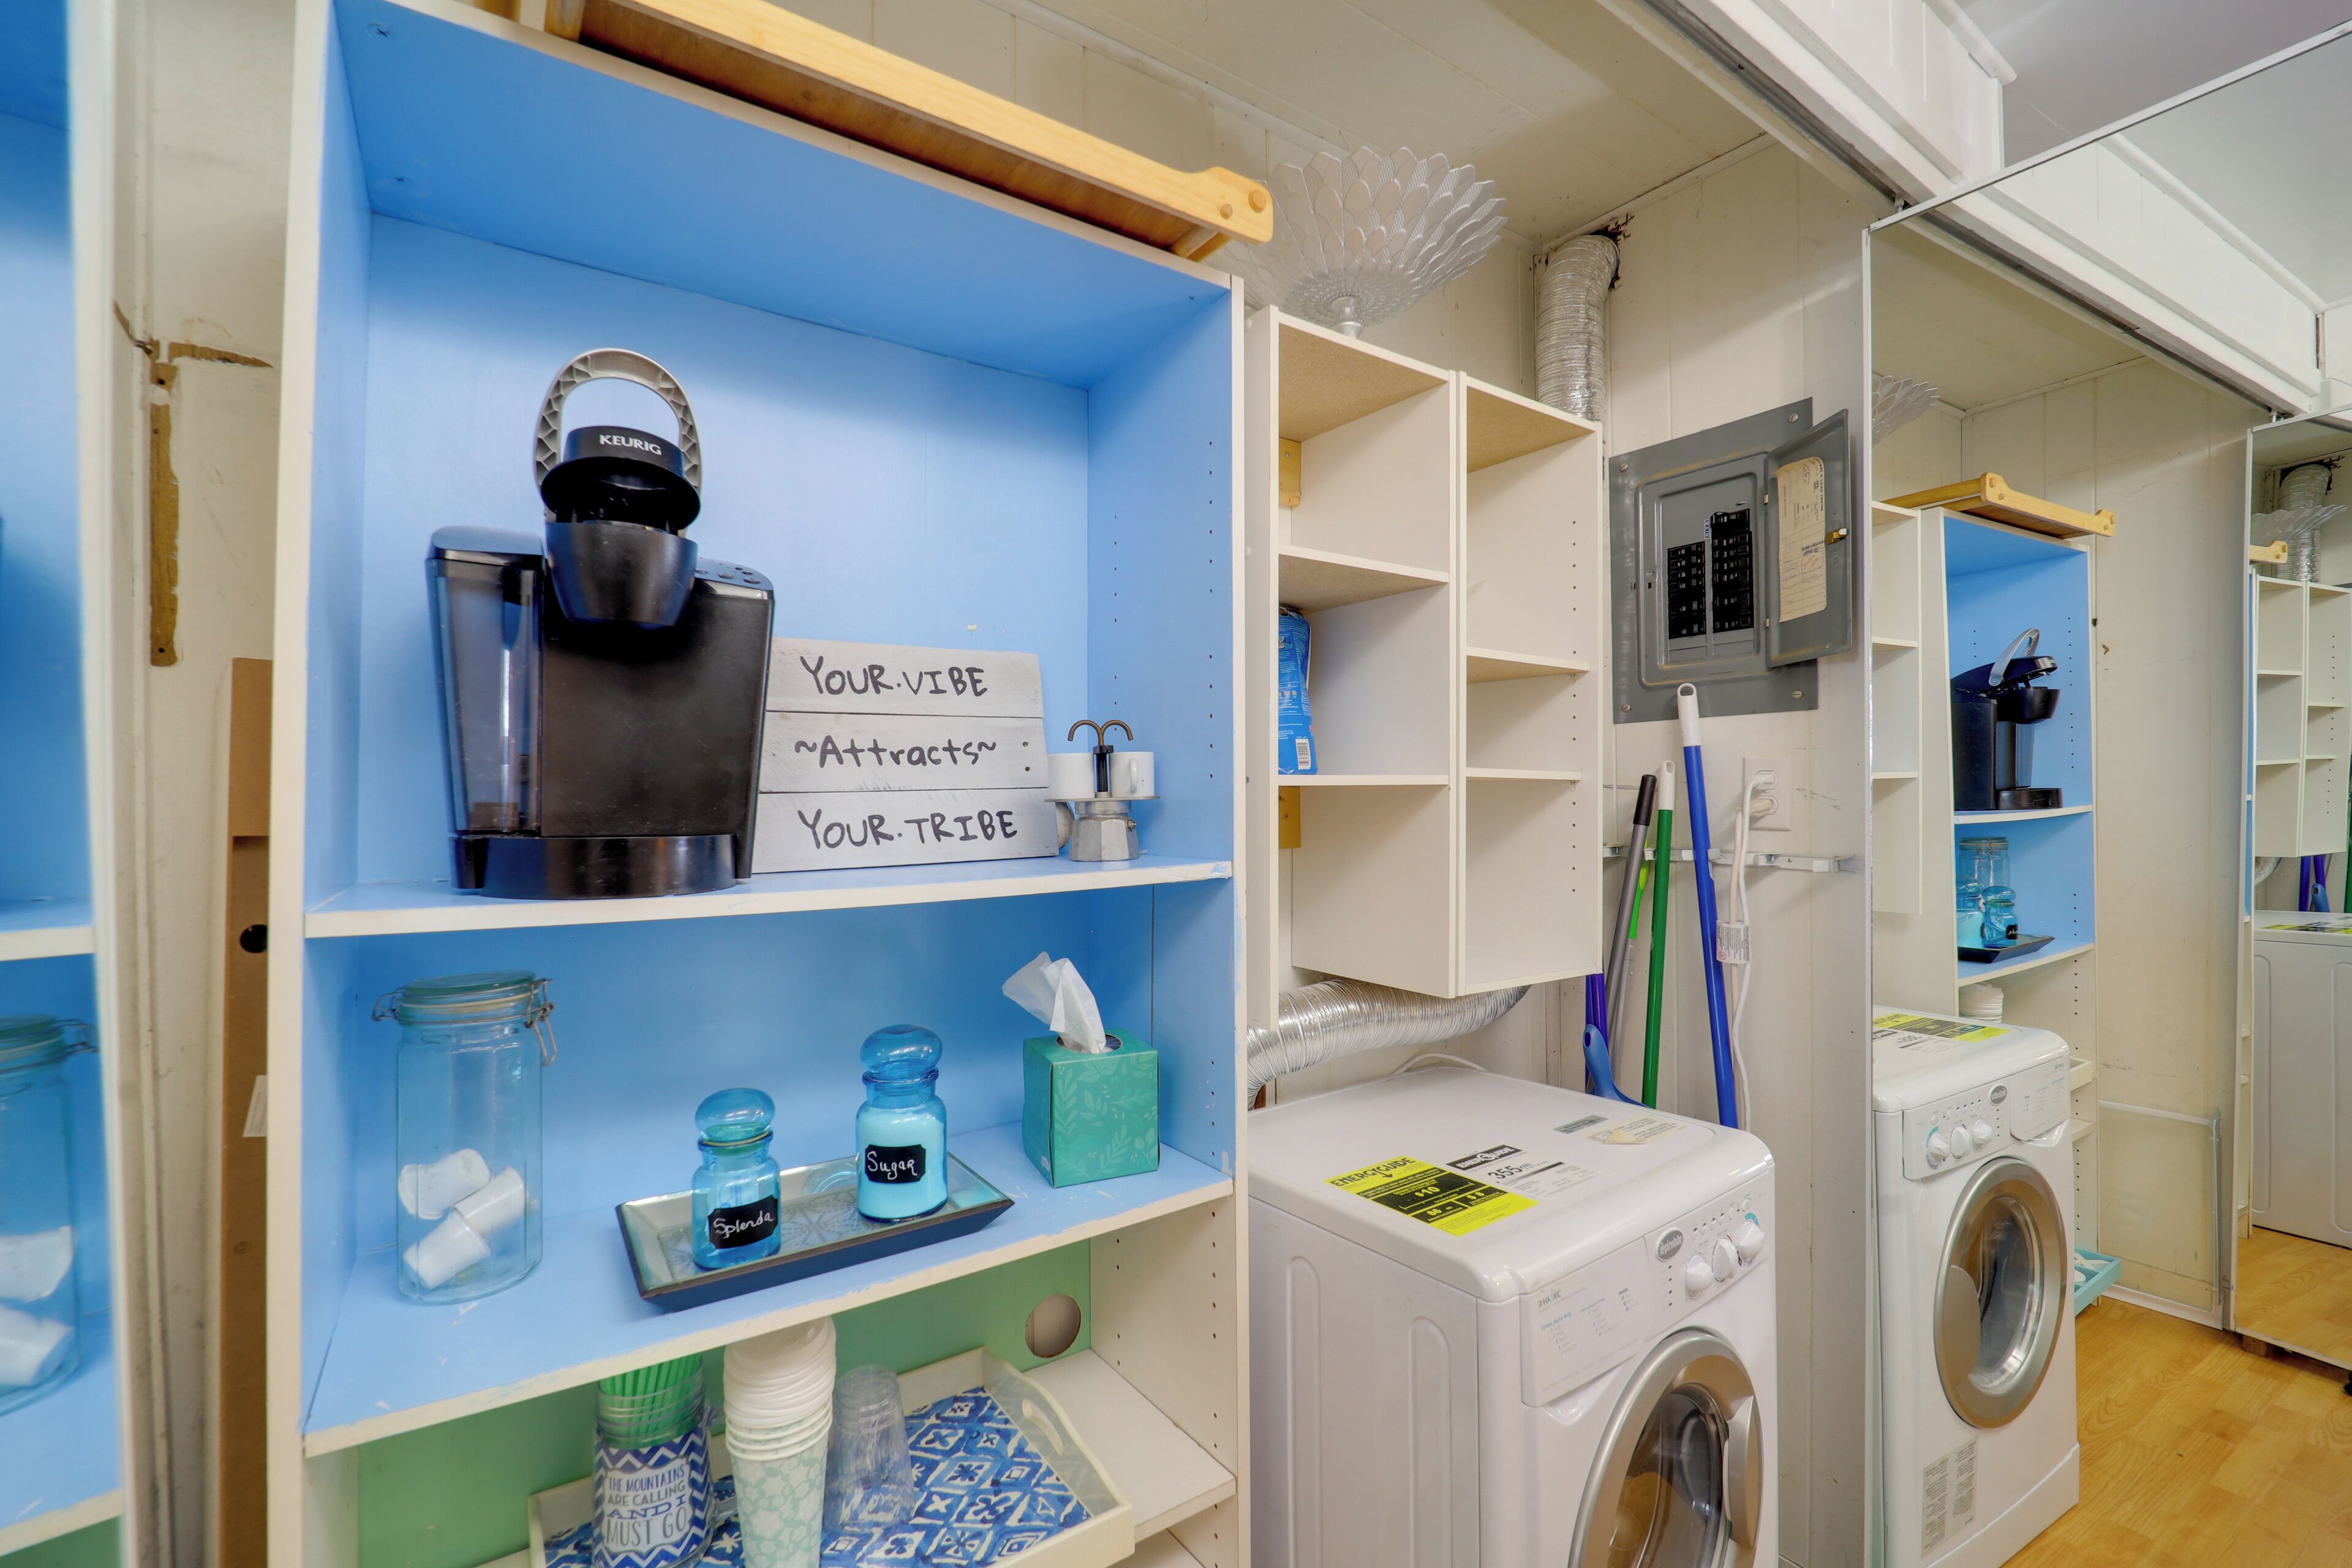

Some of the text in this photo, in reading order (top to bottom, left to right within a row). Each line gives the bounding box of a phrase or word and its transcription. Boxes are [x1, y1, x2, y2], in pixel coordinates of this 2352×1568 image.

[599, 434, 662, 455] KEURIG
[905, 810, 1017, 844] TRIBE
[867, 1150, 918, 1180] Sugar
[1487, 1165, 1523, 1179] 355
[1414, 1186, 1441, 1197] $10
[712, 1210, 776, 1239] Splenda
[609, 1464, 685, 1492] THE MOUNTAINS
[606, 1493, 687, 1520] AND I
[608, 1479, 686, 1507] ARE CALLING
[606, 1506, 687, 1547] MUST GO
